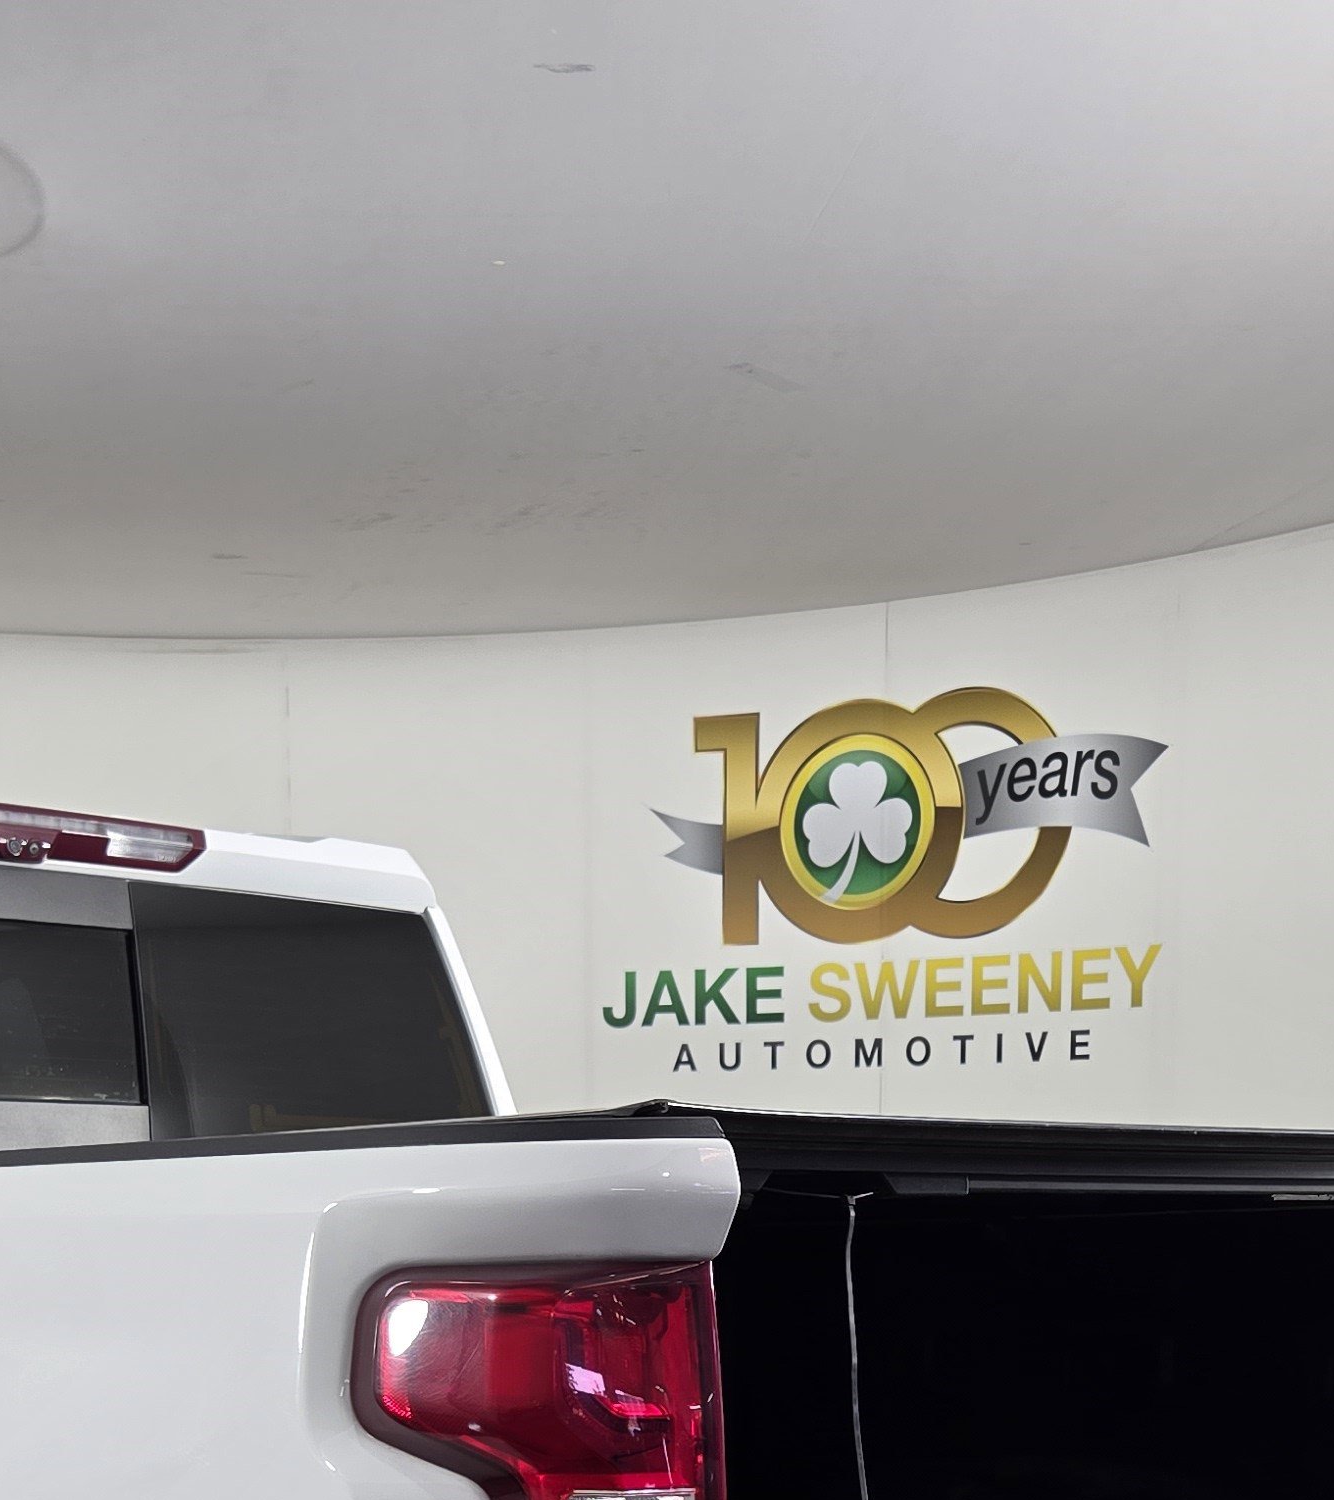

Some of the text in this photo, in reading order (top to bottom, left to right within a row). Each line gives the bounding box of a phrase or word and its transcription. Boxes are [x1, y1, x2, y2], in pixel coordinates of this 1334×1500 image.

[693, 686, 1120, 945] 100 years
[602, 944, 1162, 1028] JAKE SWEENEY
[672, 1029, 1091, 1072] AUTOMOTIVE
